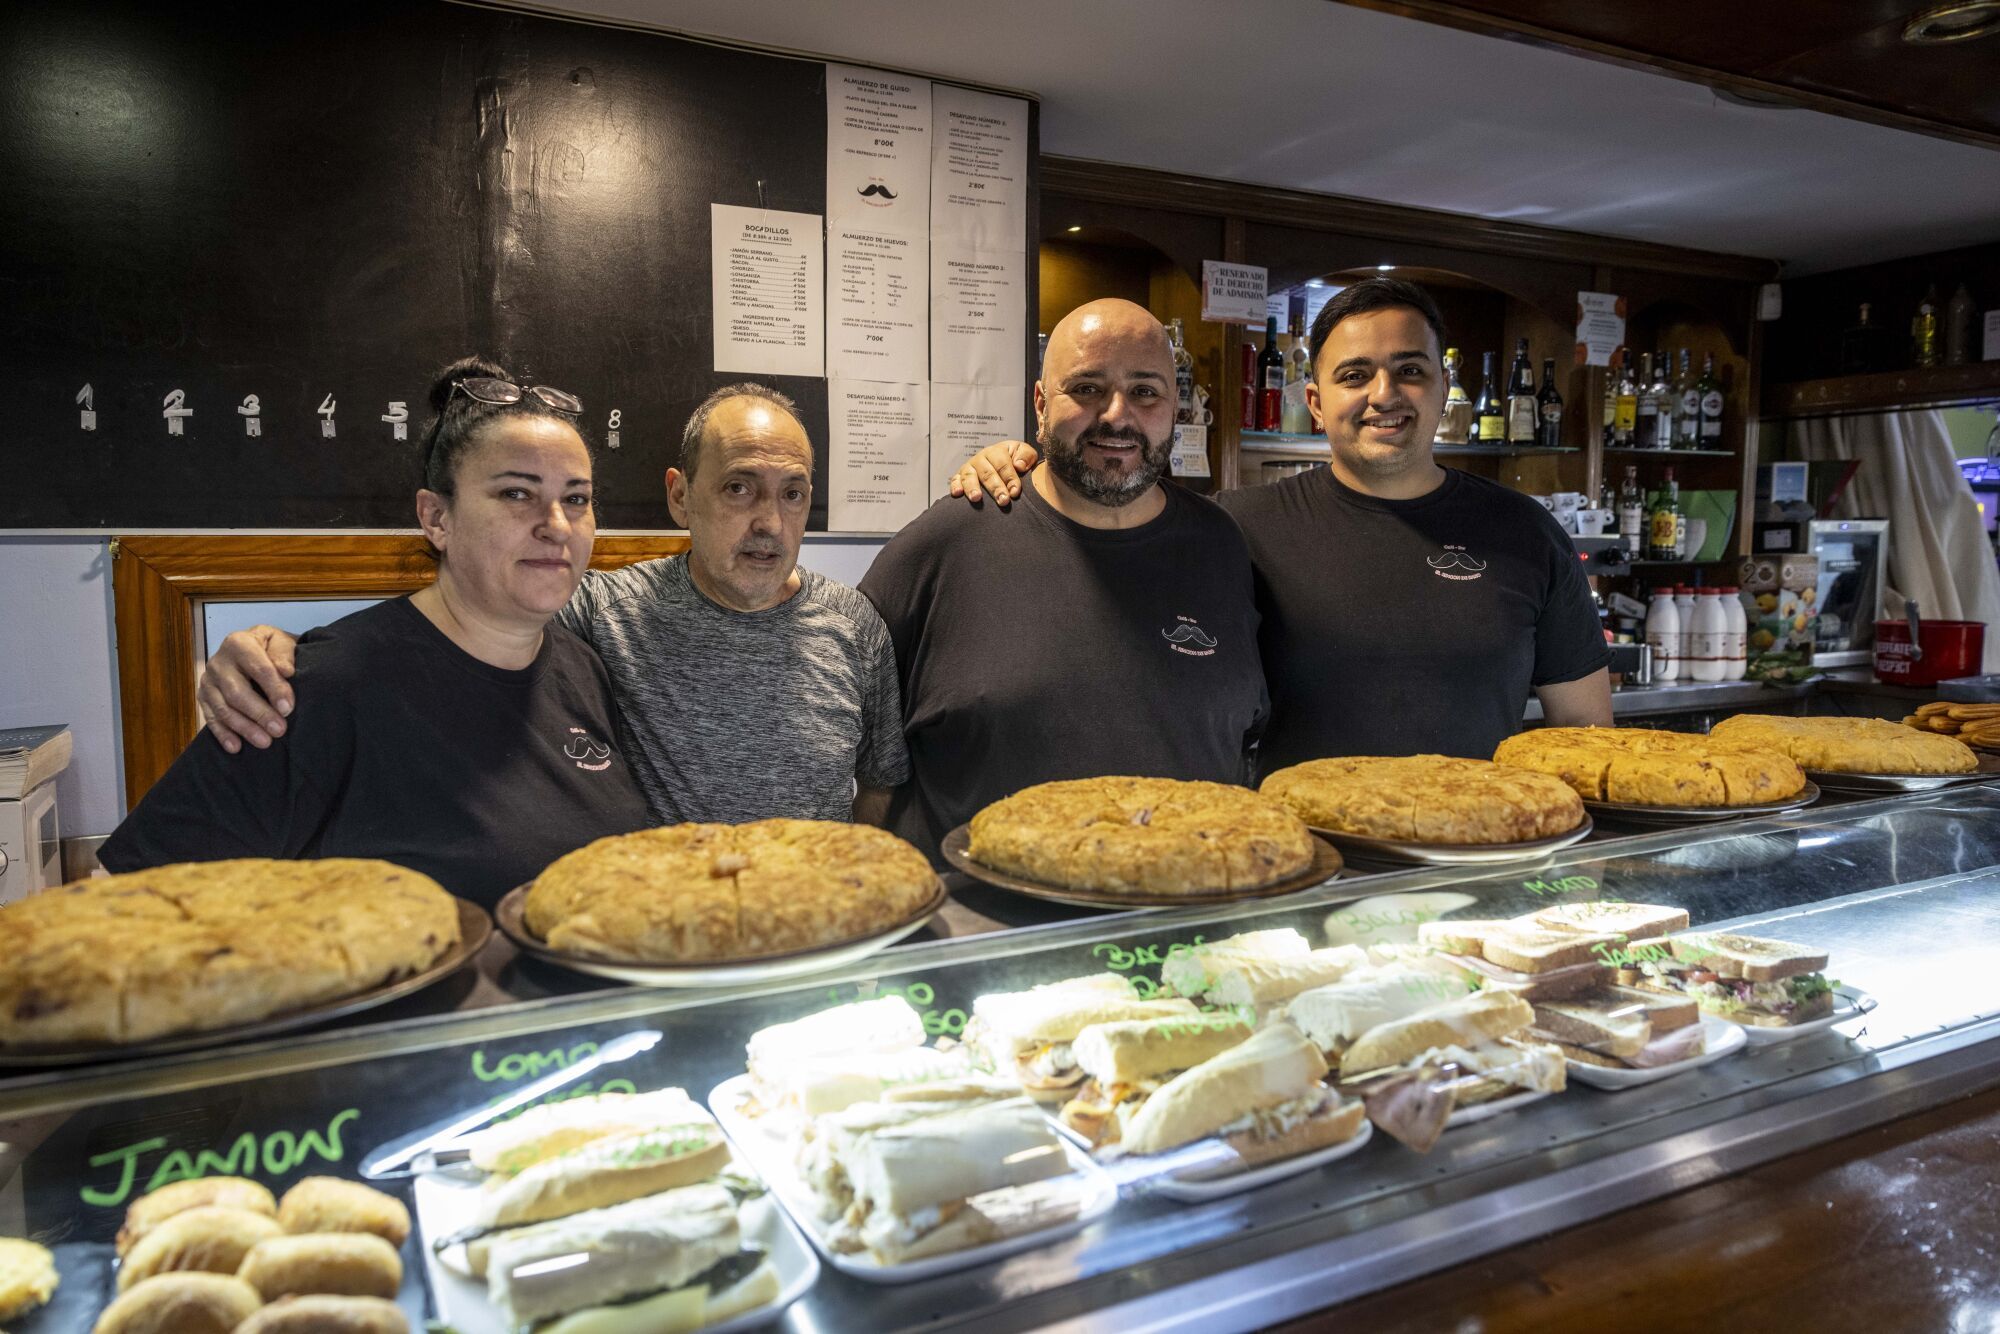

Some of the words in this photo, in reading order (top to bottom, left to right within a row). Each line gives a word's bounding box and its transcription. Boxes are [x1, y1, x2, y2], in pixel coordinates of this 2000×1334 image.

[844, 78, 878, 88] ALMUERZO
[746, 225, 789, 234] BOCADILLOS
[842, 233, 874, 241] ALMUERZO
[1220, 268, 1264, 280] RESERVADO
[1228, 279, 1263, 290] DERECHO
[1213, 287, 1224, 296] DE
[1226, 288, 1264, 300] ADMISIÓN
[163, 388, 193, 418] 2
[237, 394, 261, 416] 3
[317, 392, 336, 420] 4
[382, 401, 409, 422] 5
[608, 409, 622, 430] 8
[80, 1107, 361, 1207] JAMON
